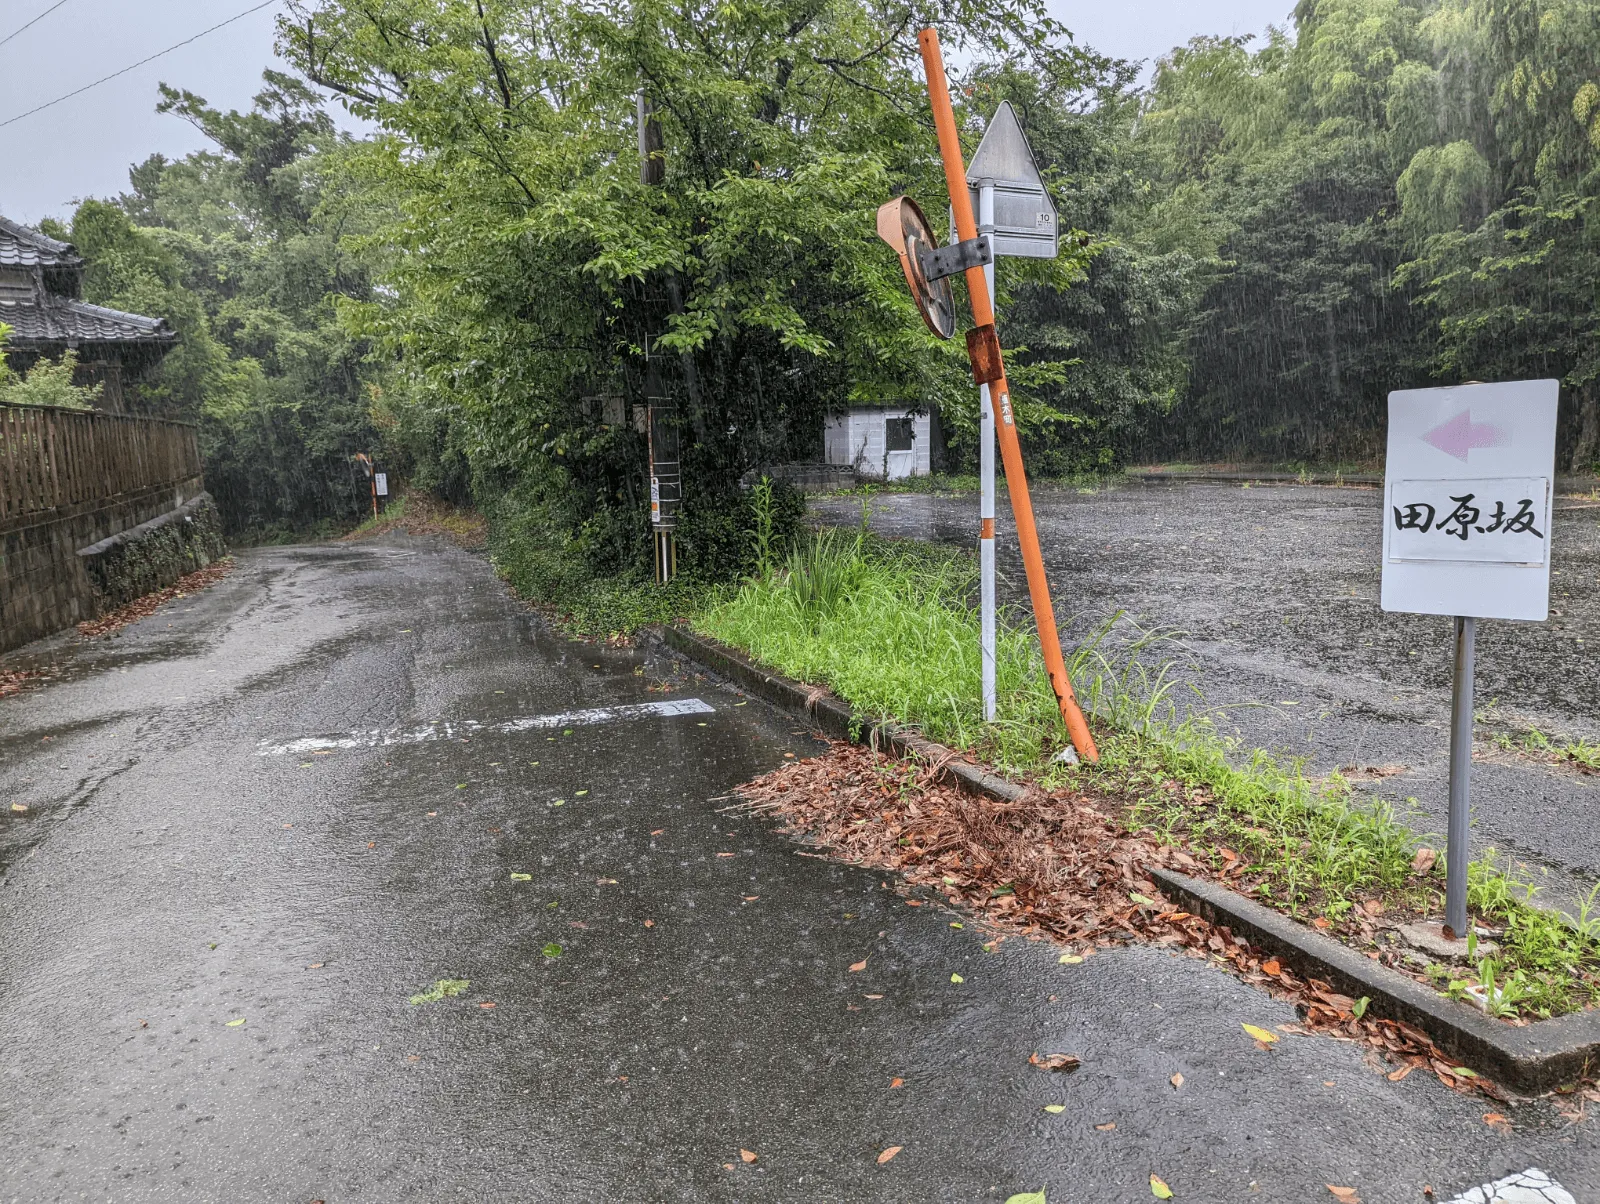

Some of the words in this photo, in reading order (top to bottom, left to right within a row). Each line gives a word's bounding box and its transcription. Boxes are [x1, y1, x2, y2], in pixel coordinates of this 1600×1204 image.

[1040, 213, 1050, 222] 10
[1393, 493, 1544, 541] 田原坂
